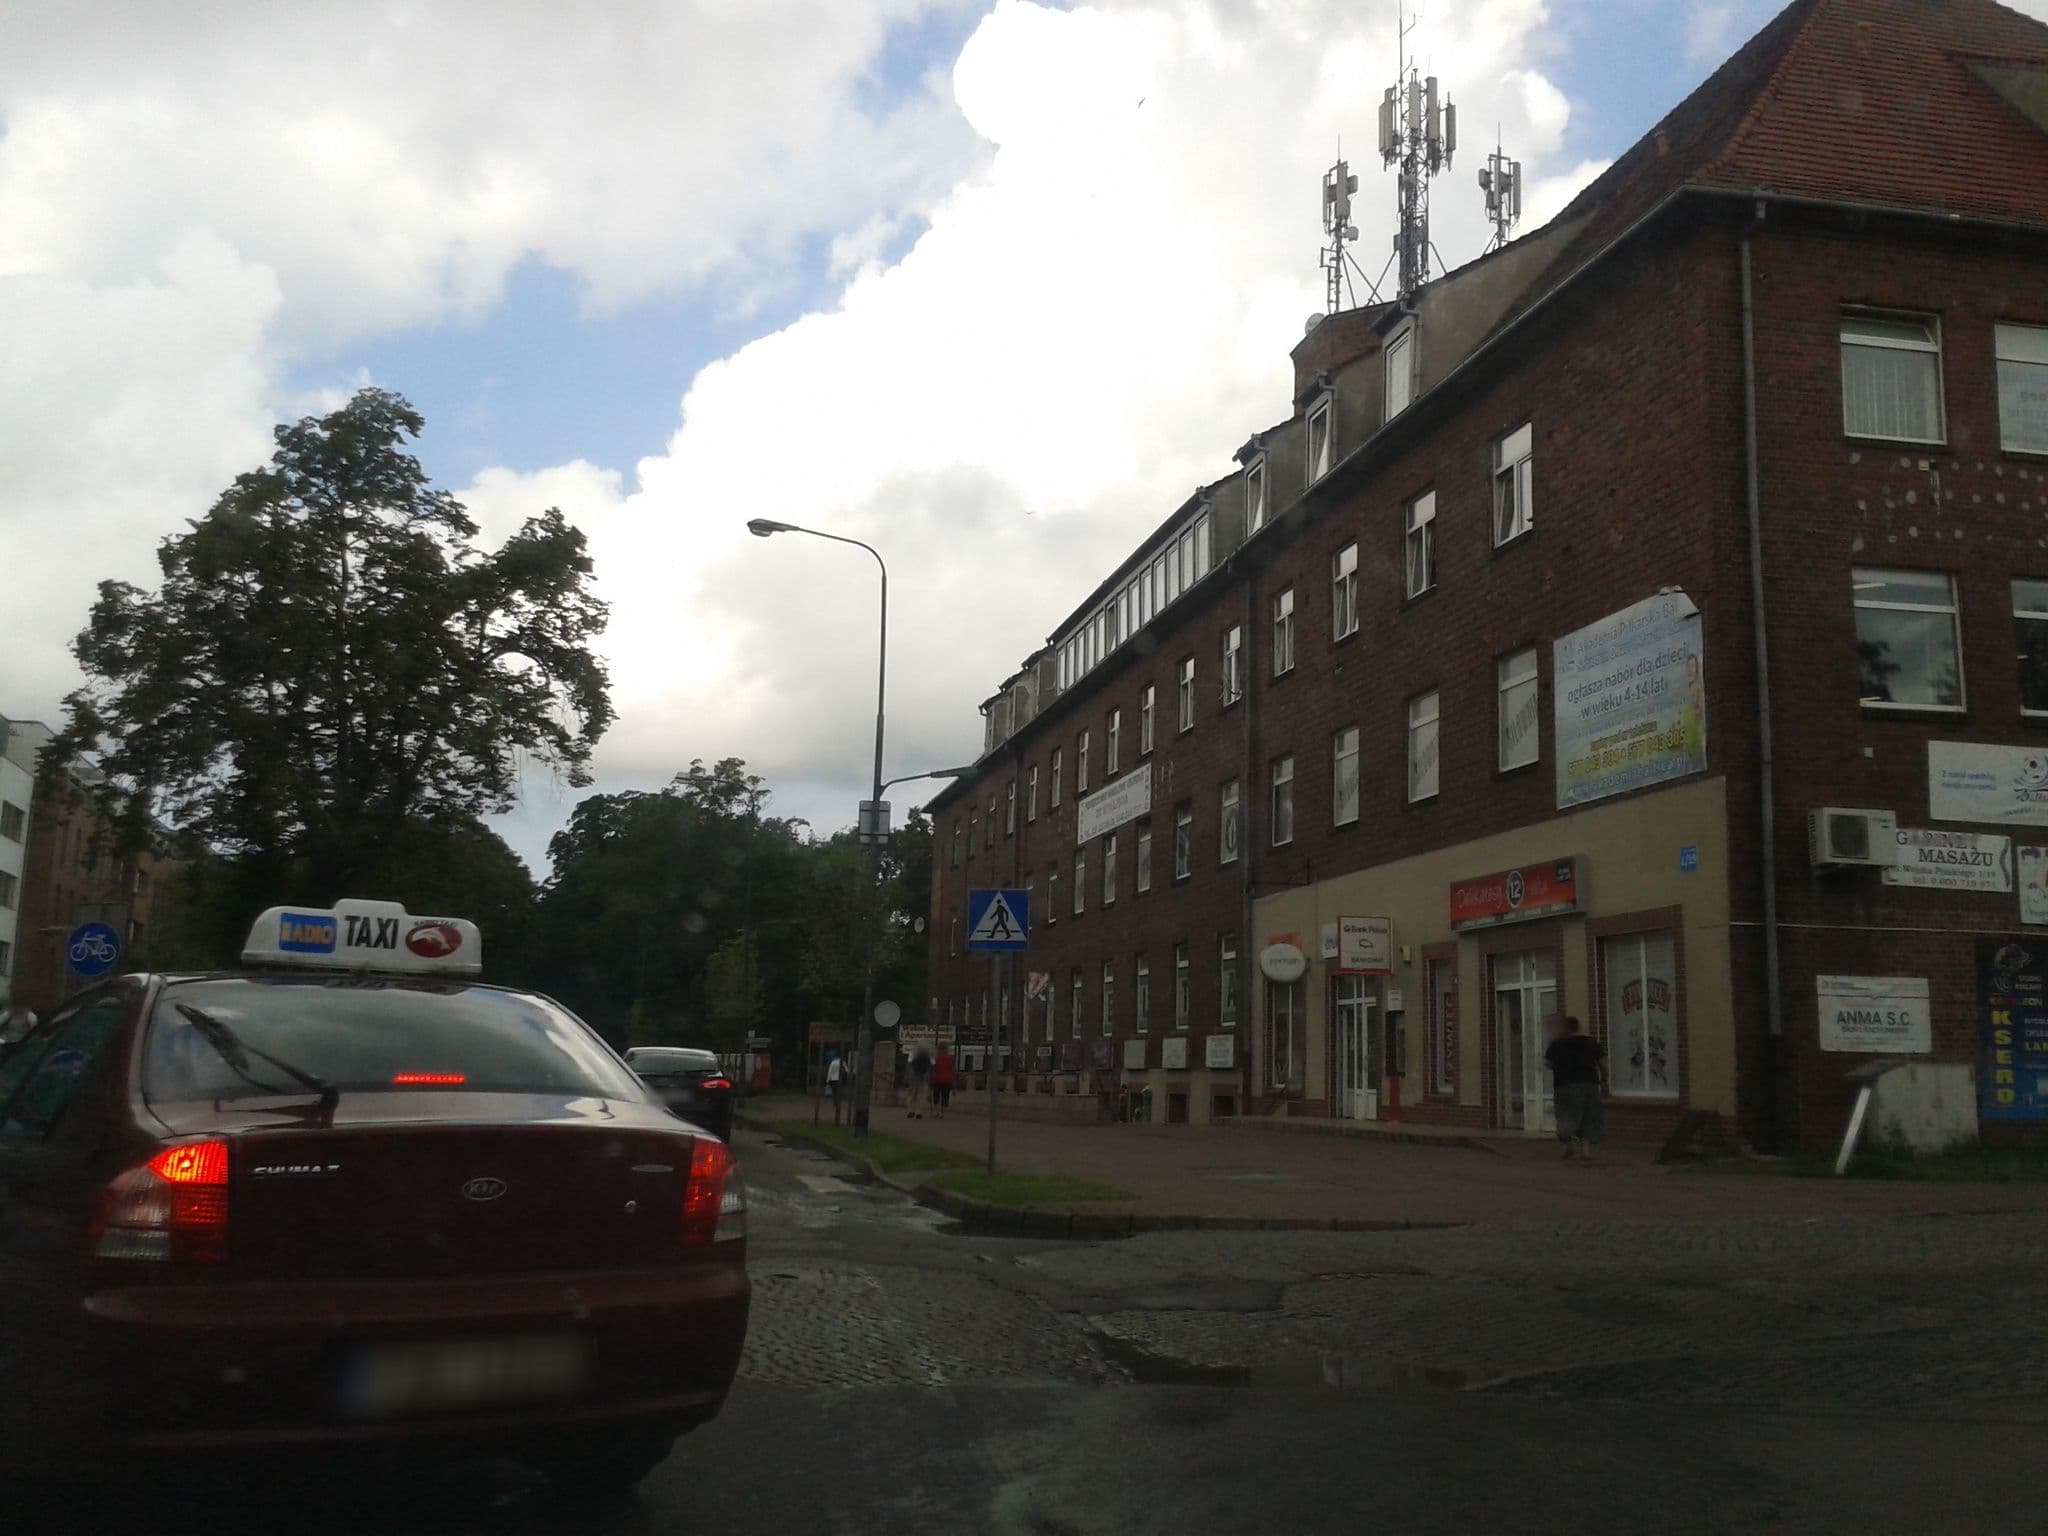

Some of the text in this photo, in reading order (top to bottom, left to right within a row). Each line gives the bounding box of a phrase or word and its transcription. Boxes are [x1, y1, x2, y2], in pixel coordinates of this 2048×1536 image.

[1636, 655, 1653, 681] dla
[1655, 642, 1688, 673] dzieci
[1593, 693, 1622, 715] wieku
[1510, 880, 1521, 899] 12
[280, 915, 400, 949] RADIO TAXI
[1836, 1010, 1882, 1025] ANMA
[1991, 1010, 2016, 1104] KSERO
